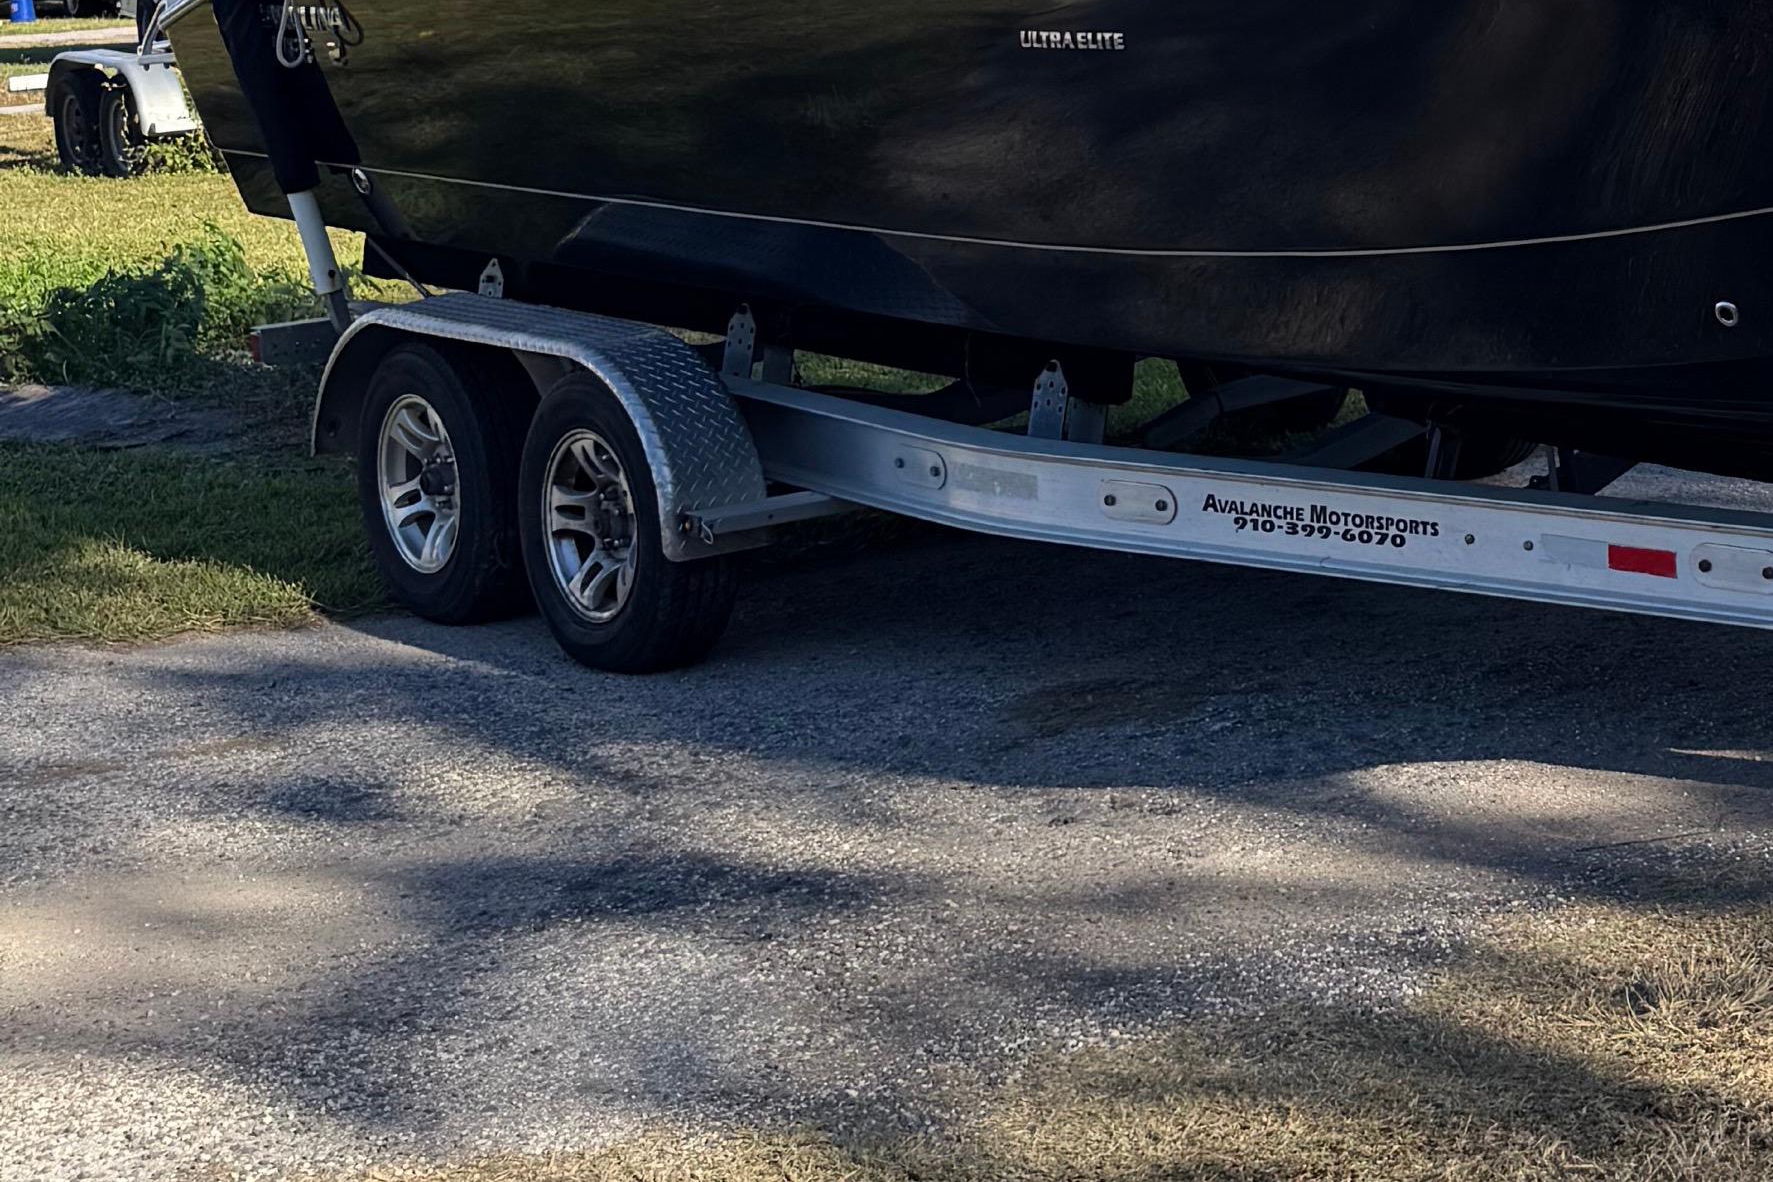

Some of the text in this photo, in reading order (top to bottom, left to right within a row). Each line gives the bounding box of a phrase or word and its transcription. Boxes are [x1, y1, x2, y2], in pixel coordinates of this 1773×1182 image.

[1019, 30, 1125, 50] ULTRA ELITE
[1202, 493, 1440, 537] AVALANCHE MOTORSPORTS
[1233, 516, 1407, 548] 910-399-6070
